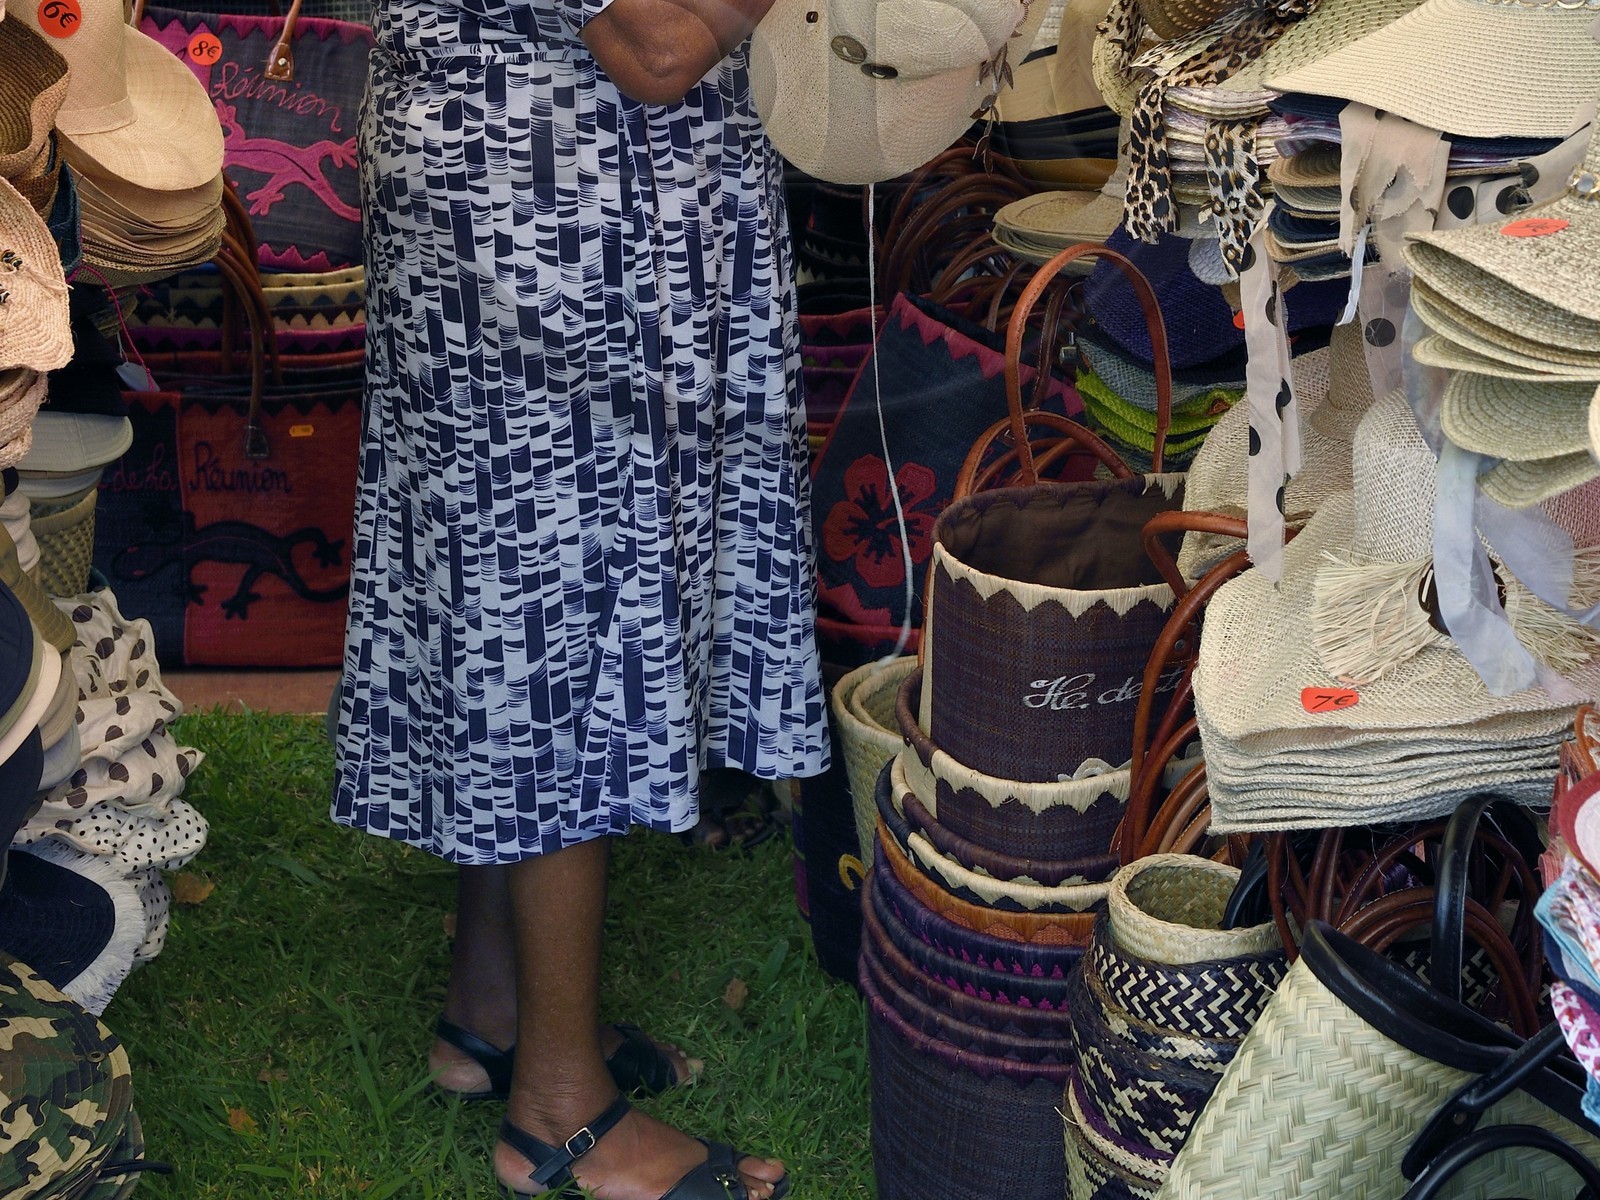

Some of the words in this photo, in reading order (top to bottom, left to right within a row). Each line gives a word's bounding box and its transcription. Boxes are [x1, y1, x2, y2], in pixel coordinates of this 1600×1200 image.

[43, 0, 79, 29] 6€
[191, 40, 220, 58] 8€
[210, 60, 343, 133] Réunion
[188, 440, 294, 495] Réunion
[1312, 694, 1355, 710] 7€
